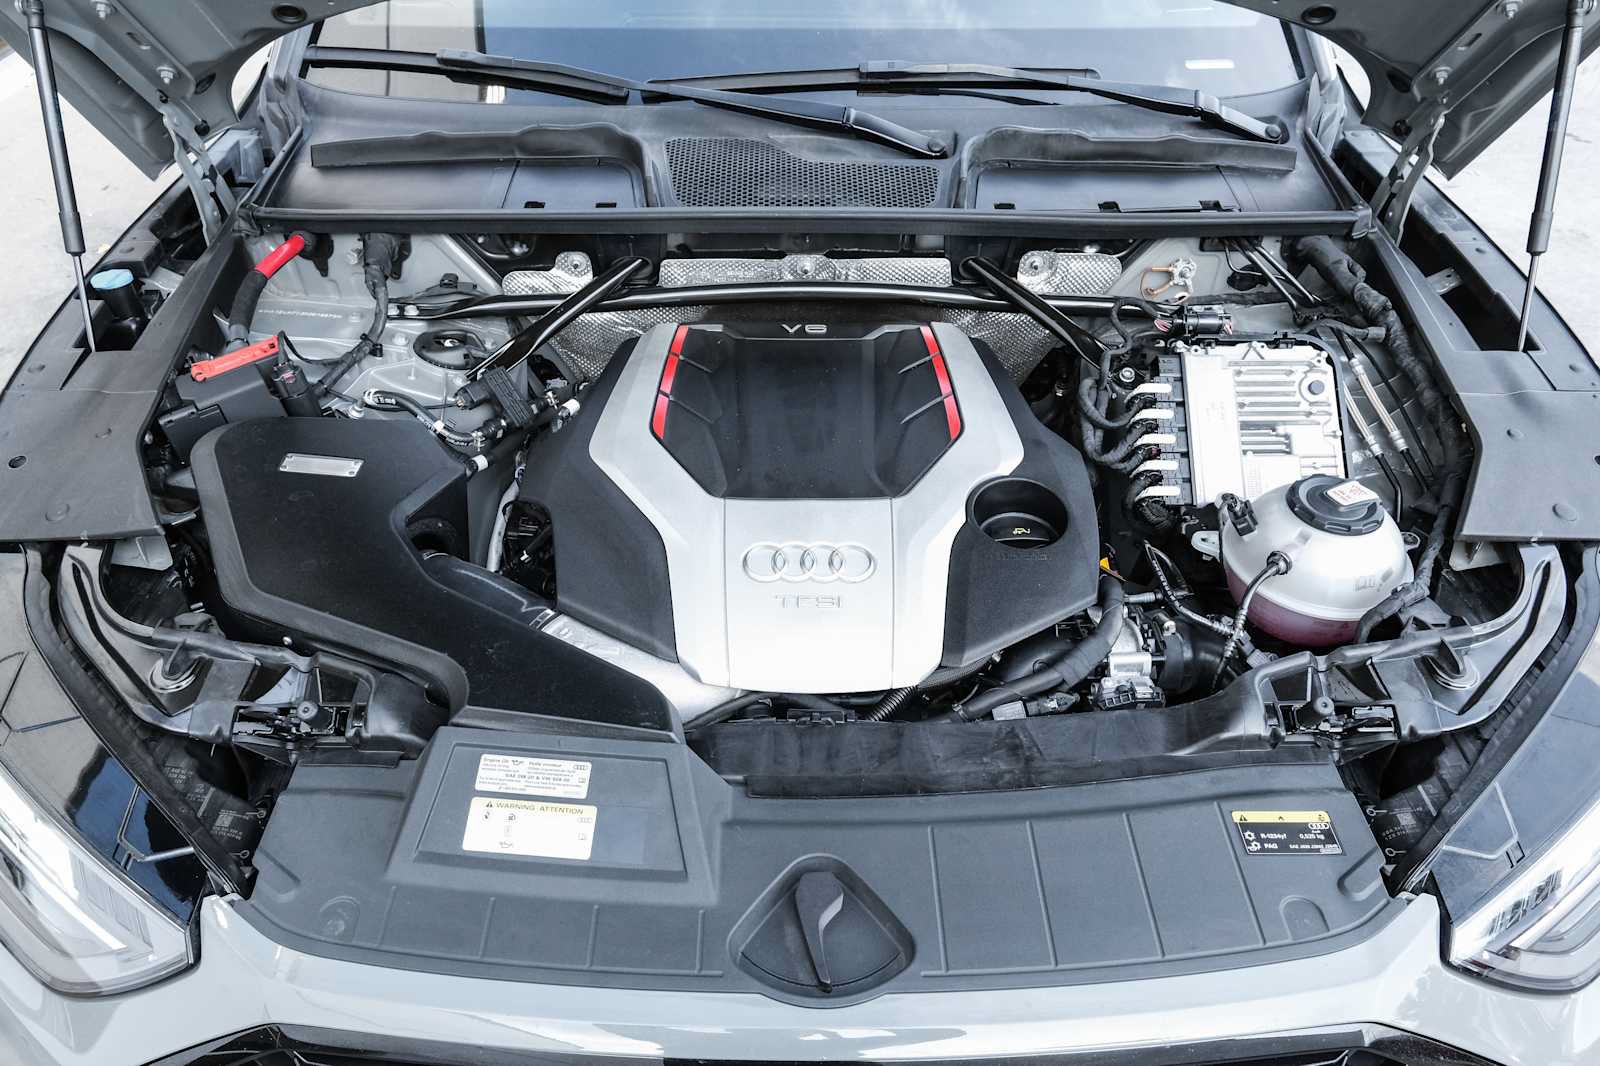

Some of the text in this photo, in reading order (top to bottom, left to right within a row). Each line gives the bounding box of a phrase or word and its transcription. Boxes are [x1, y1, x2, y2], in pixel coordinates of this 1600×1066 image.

[781, 324, 827, 333] V6
[496, 802, 584, 815] WARNING ATTENTION
